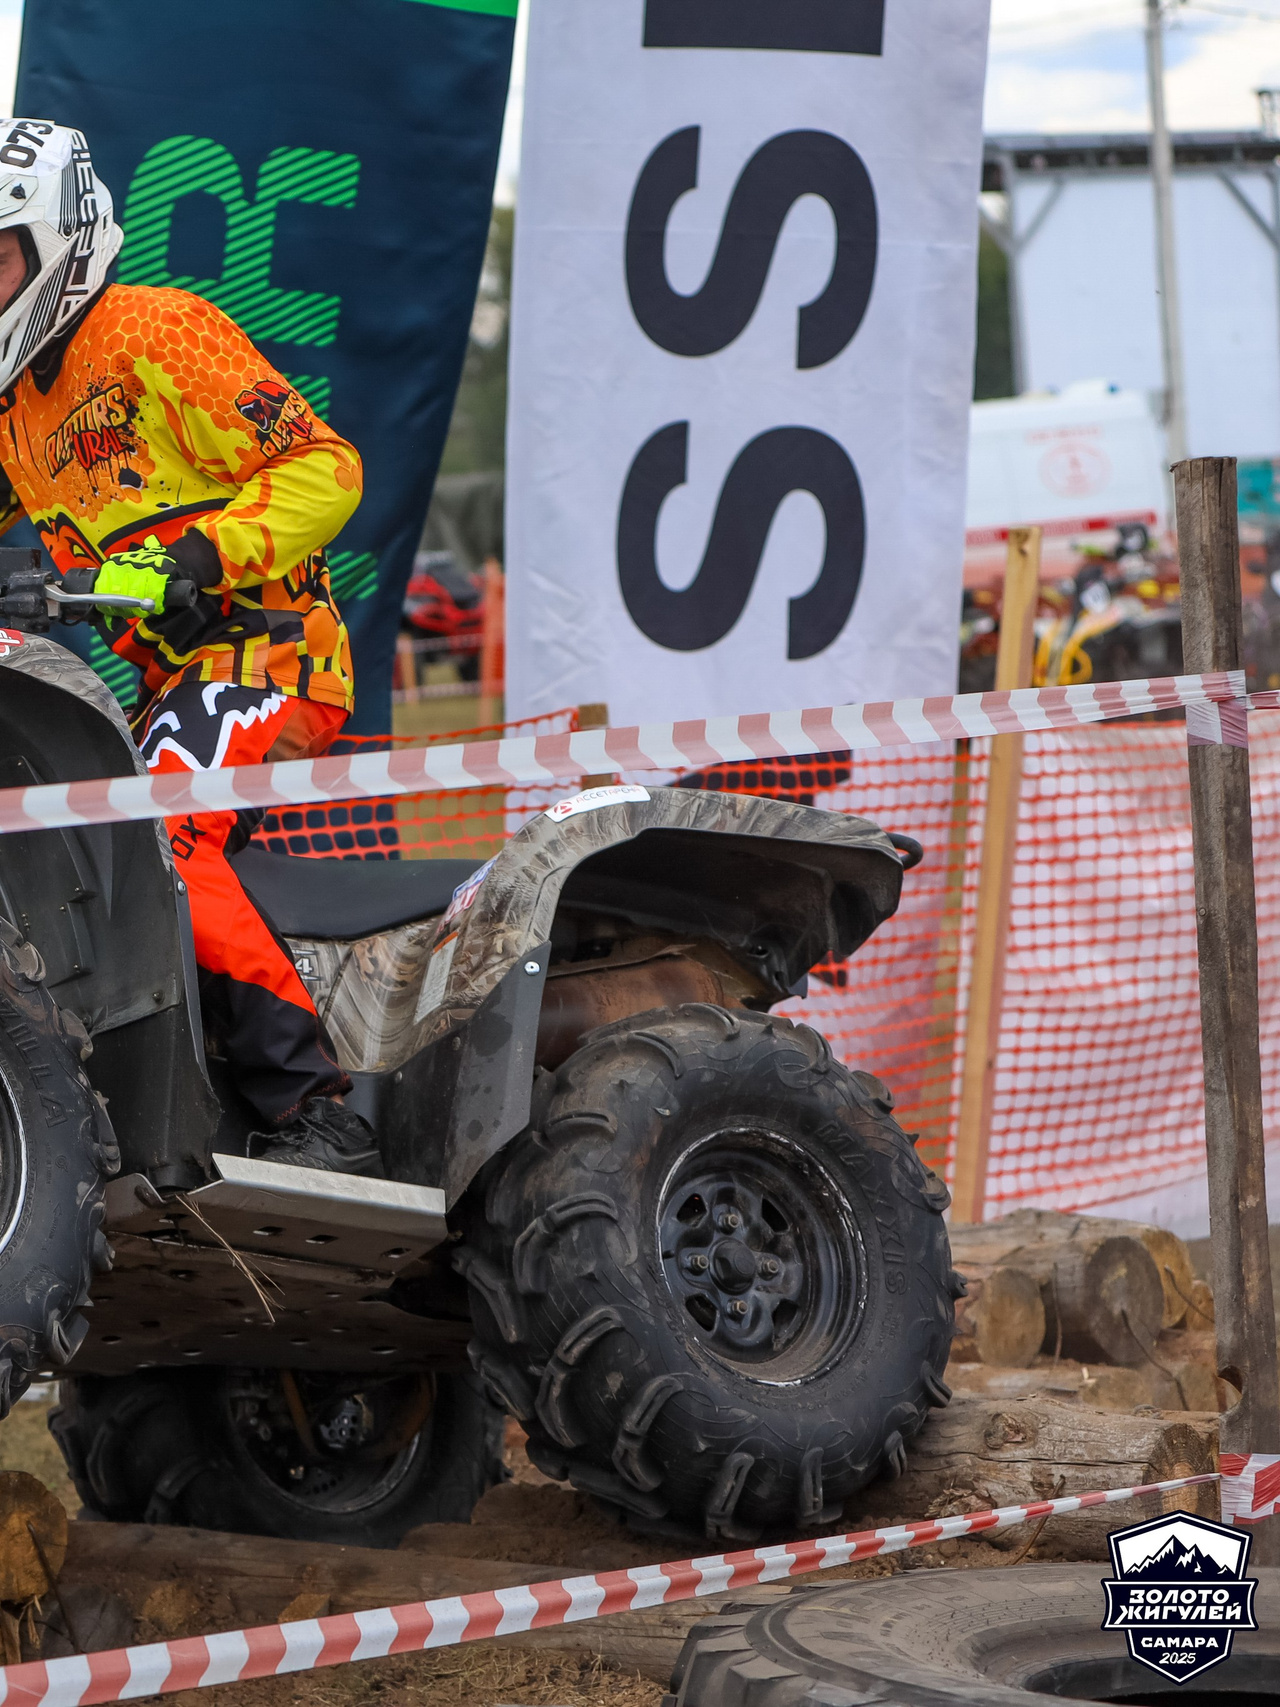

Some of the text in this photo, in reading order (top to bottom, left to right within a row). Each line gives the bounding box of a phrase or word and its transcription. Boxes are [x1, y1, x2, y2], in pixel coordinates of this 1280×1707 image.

[0, 120, 54, 168] 073
[45, 385, 128, 475] RAPTORS
[73, 425, 127, 469] URAL
[817, 1119, 908, 1296] MAXXIS
